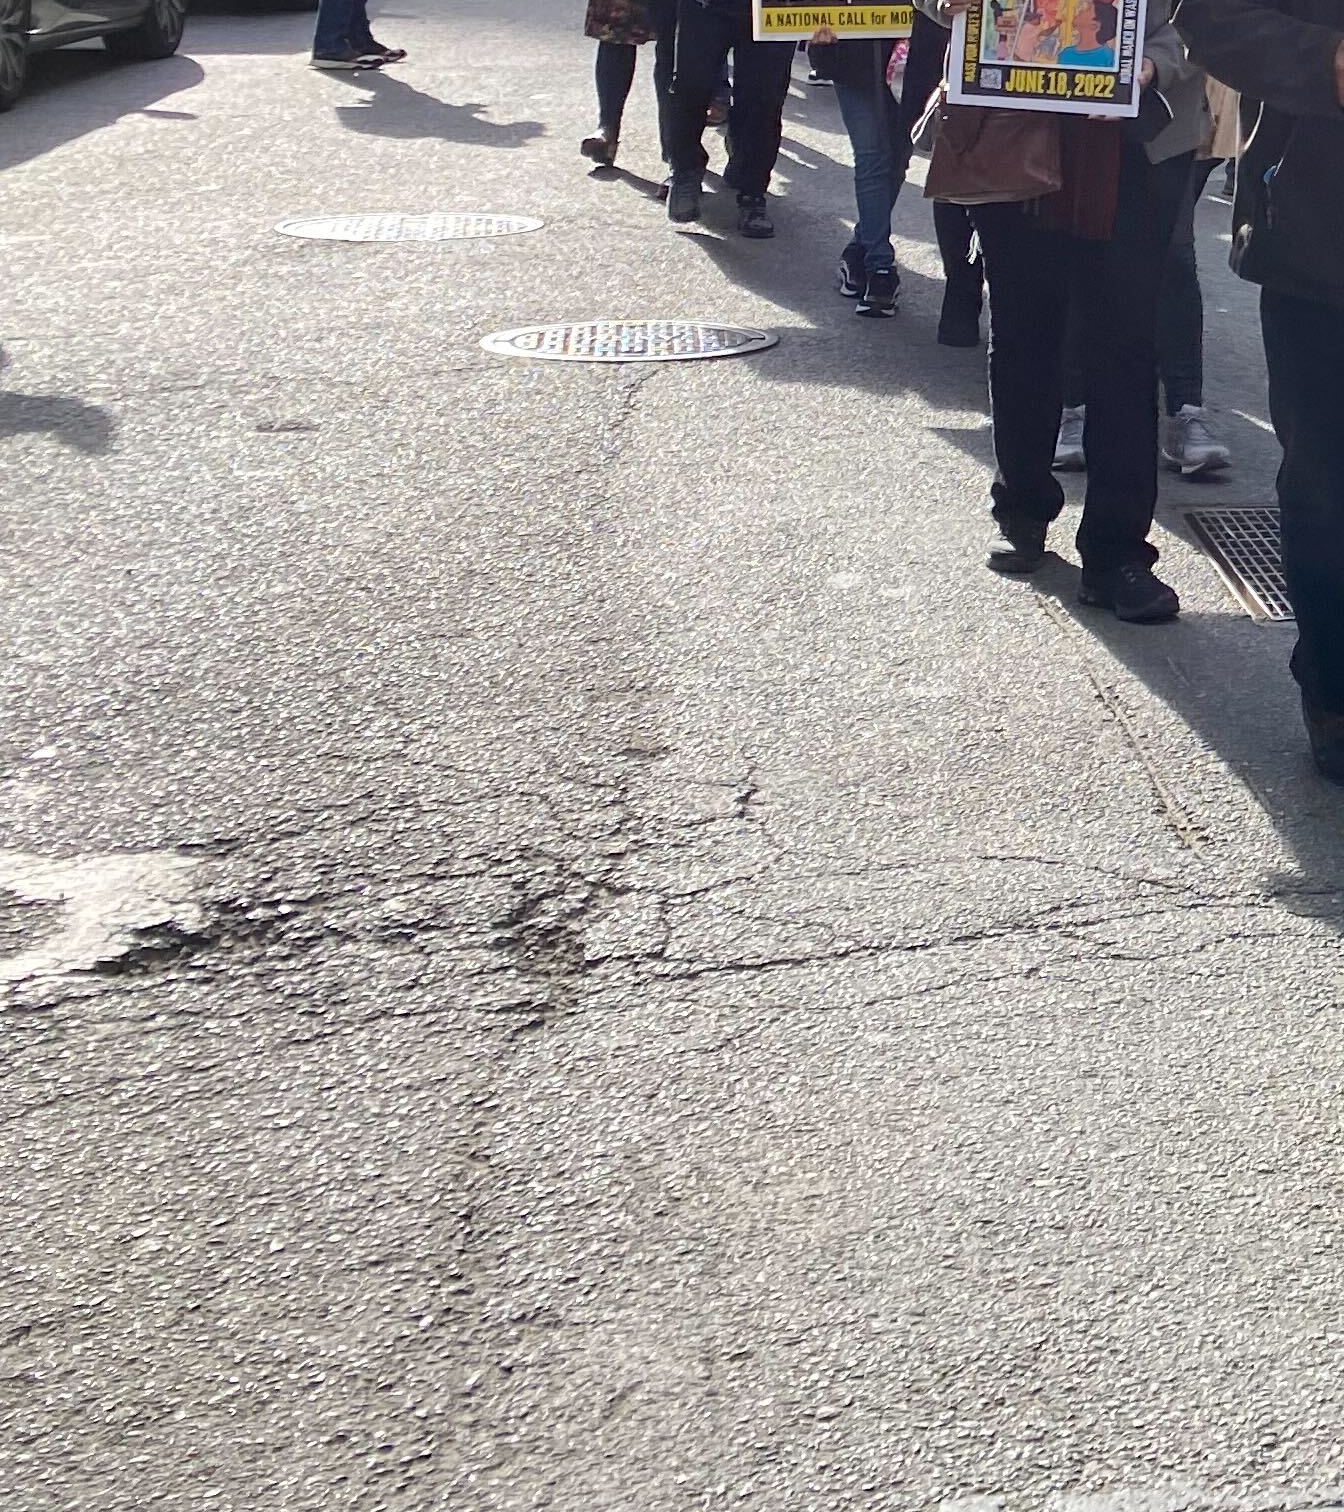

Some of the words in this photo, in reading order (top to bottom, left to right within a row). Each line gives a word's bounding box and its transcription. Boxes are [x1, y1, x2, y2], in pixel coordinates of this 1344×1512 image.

[765, 14, 773, 27] A
[776, 12, 835, 27] NATIONAL
[838, 11, 866, 26] CALL
[871, 11, 887, 26] for
[1005, 68, 1049, 93] JUNE
[1048, 72, 1073, 99] 18,
[1074, 73, 1115, 99] 2022
